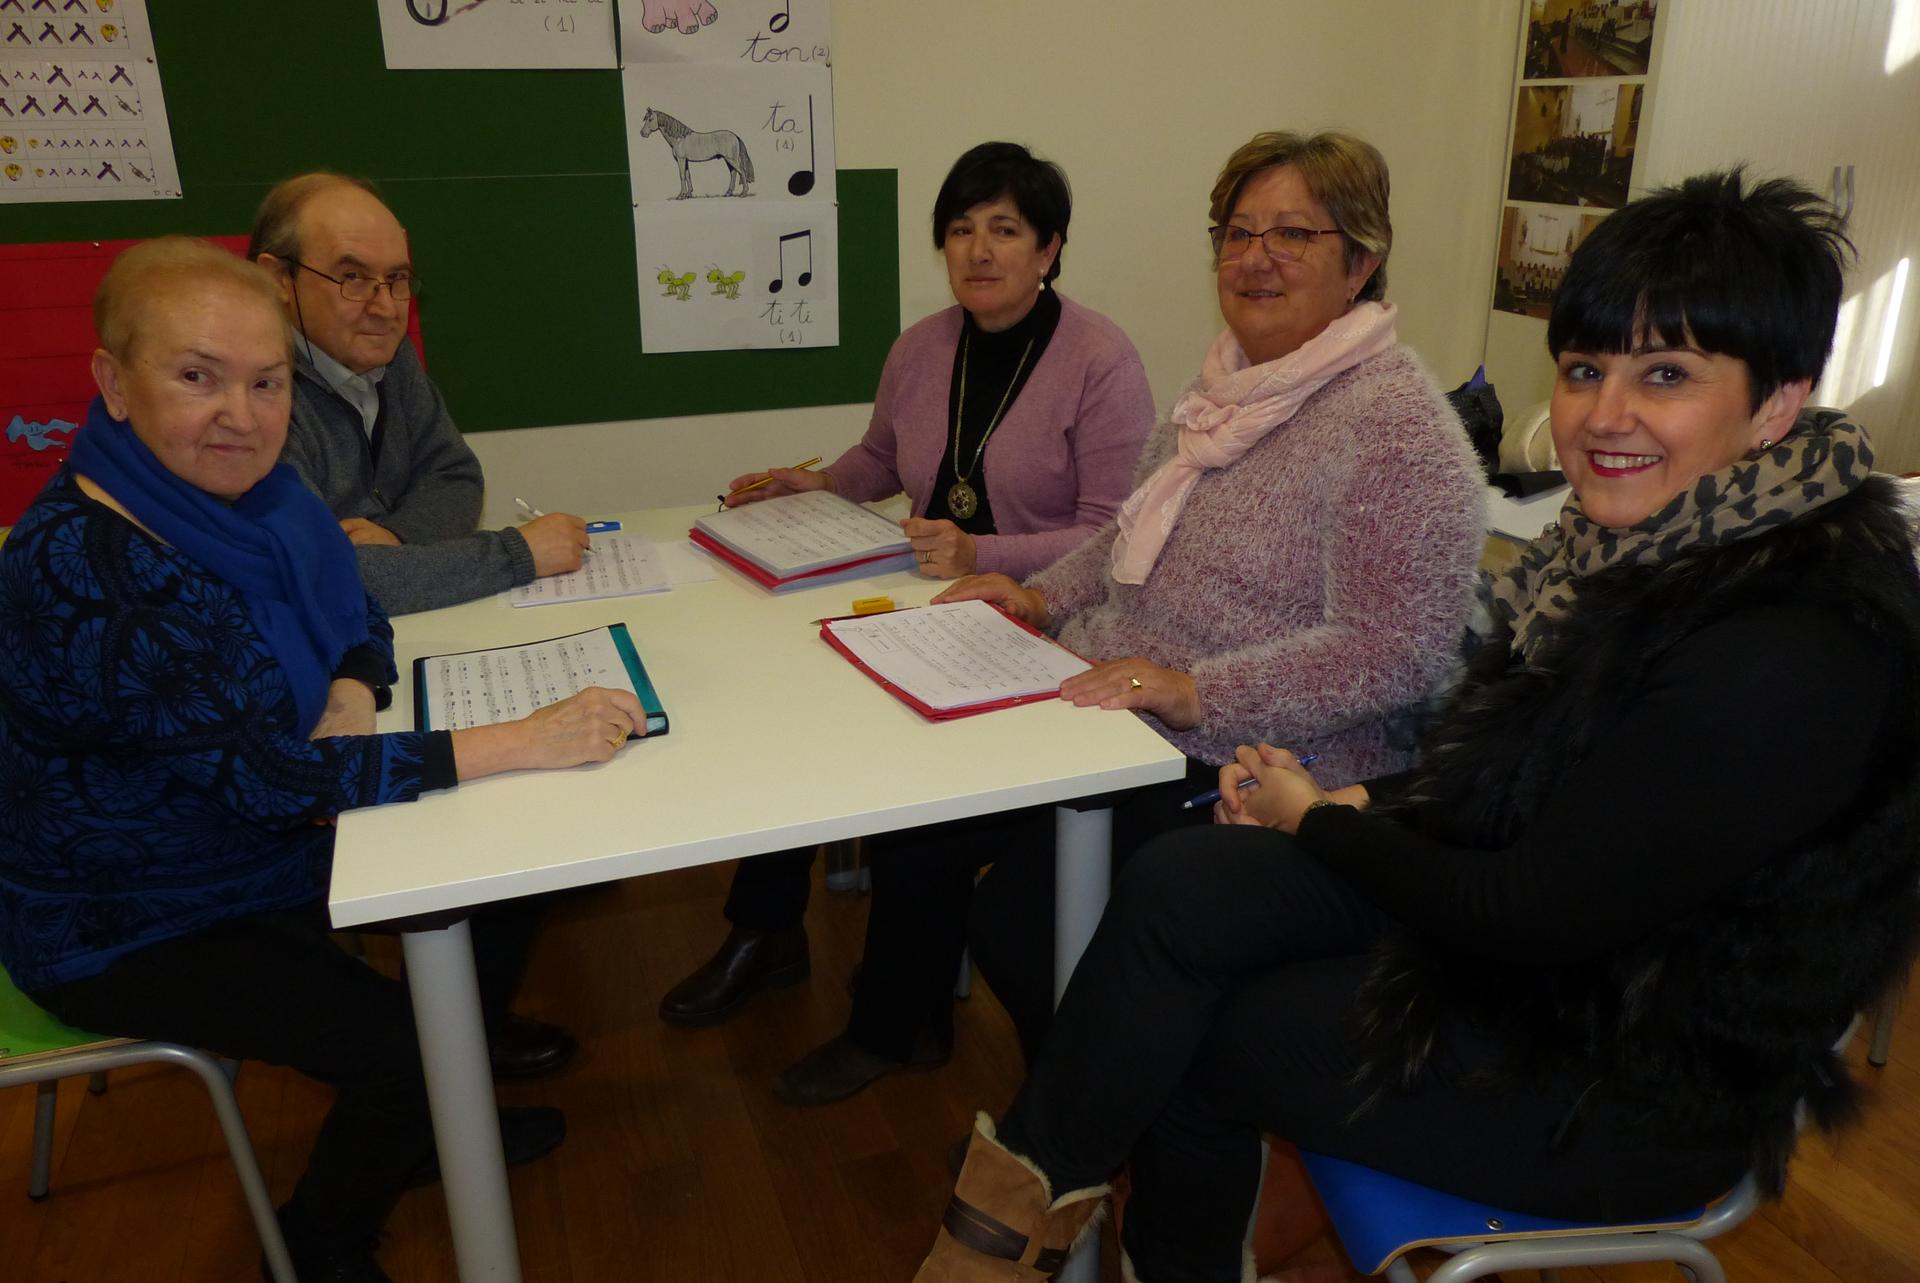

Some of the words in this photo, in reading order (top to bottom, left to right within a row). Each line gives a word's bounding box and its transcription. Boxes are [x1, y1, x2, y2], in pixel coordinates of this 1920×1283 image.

[544, 15, 575, 33] (1)
[740, 31, 809, 63] ton
[812, 46, 830, 61] (2)
[762, 101, 803, 134] ta
[760, 299, 785, 326] ti
[789, 299, 814, 324] ti
[780, 328, 802, 345] (1)
